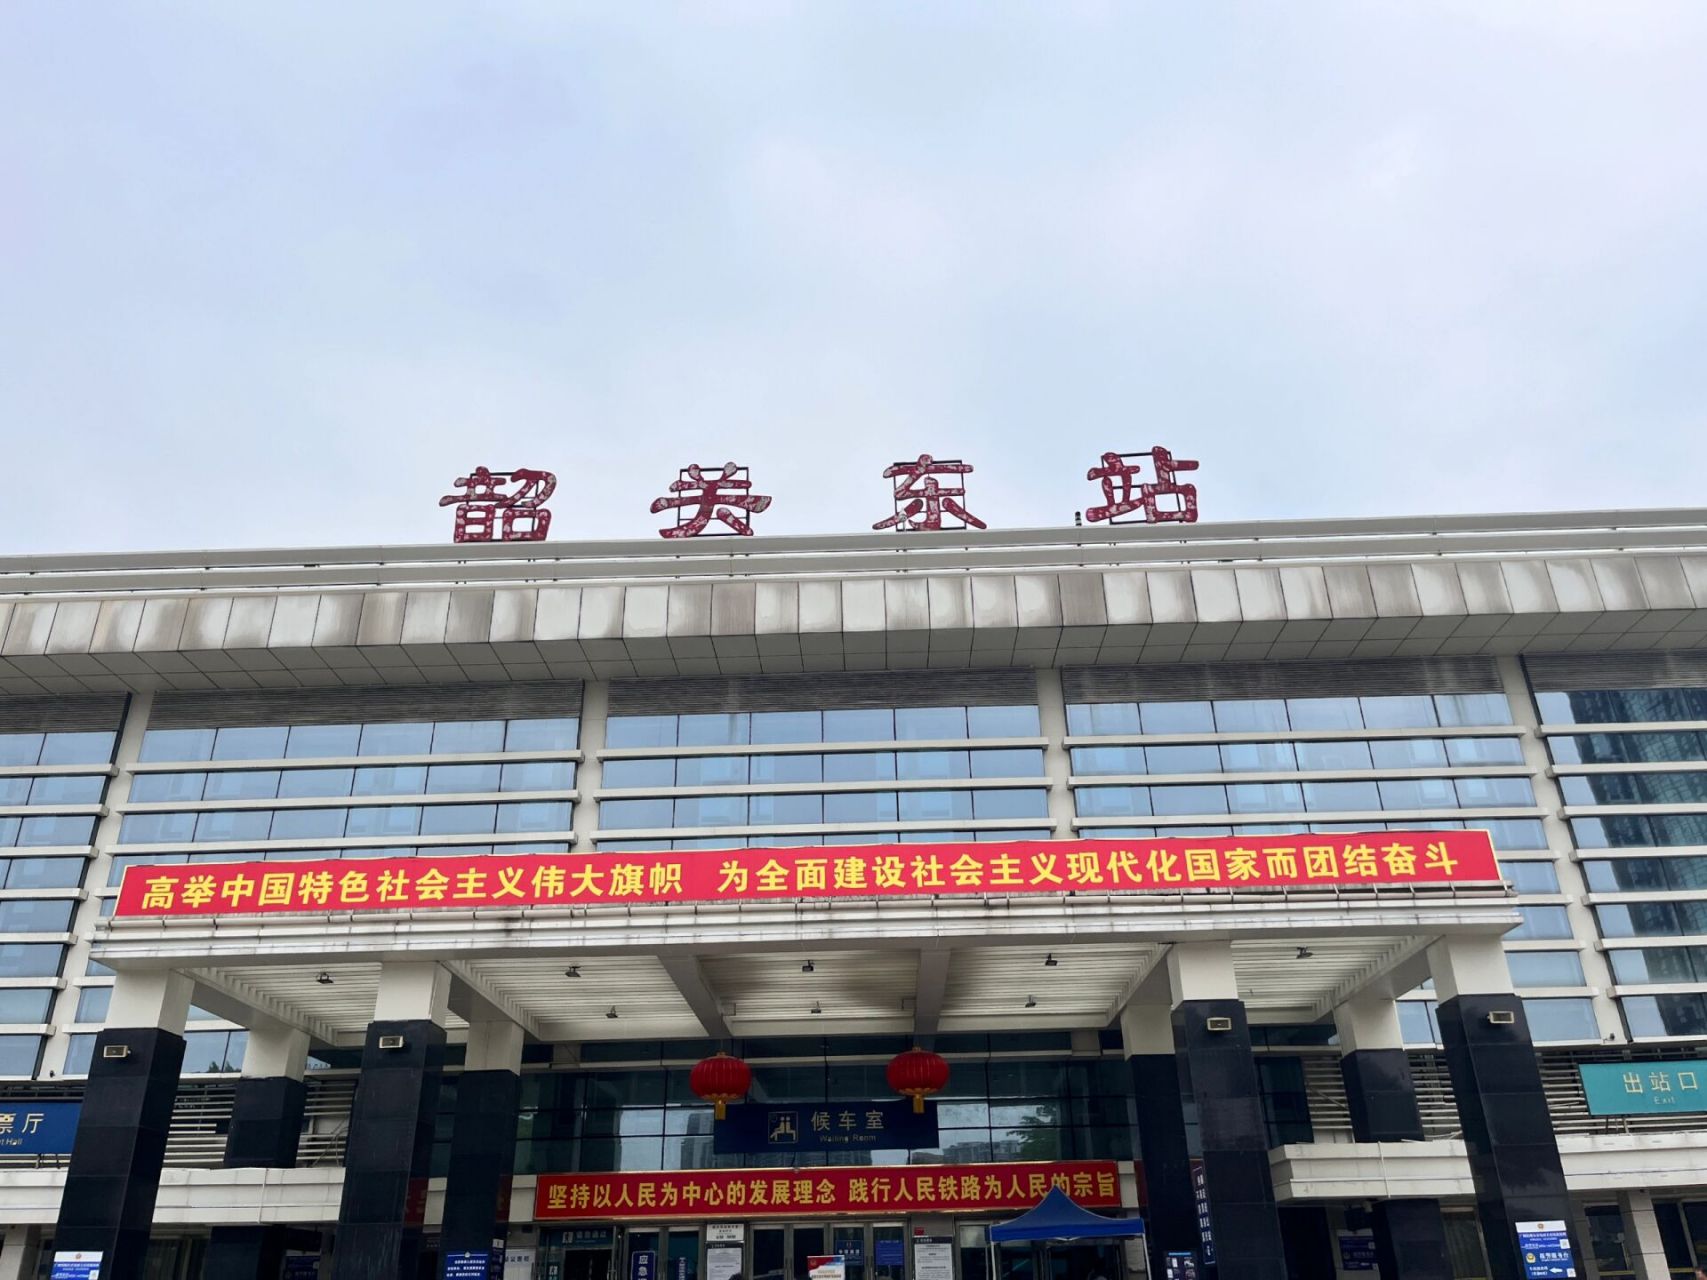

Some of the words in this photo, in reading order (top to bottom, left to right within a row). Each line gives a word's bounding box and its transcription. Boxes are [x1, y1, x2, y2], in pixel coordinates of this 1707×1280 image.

[440, 446, 1200, 543] 韶关东站
[141, 862, 684, 910] 高举中国特色社会主义伟大旗帜
[716, 841, 1459, 893] 为全面建设社会主义现代化国家而团结奋斗
[1623, 1071, 1699, 1094] 出站口
[811, 1109, 884, 1131] 候车室
[547, 1178, 836, 1209] 坚持以人民为中心的发展理念
[848, 1171, 1115, 1204] 践行人民铁路为人民的宗旨
